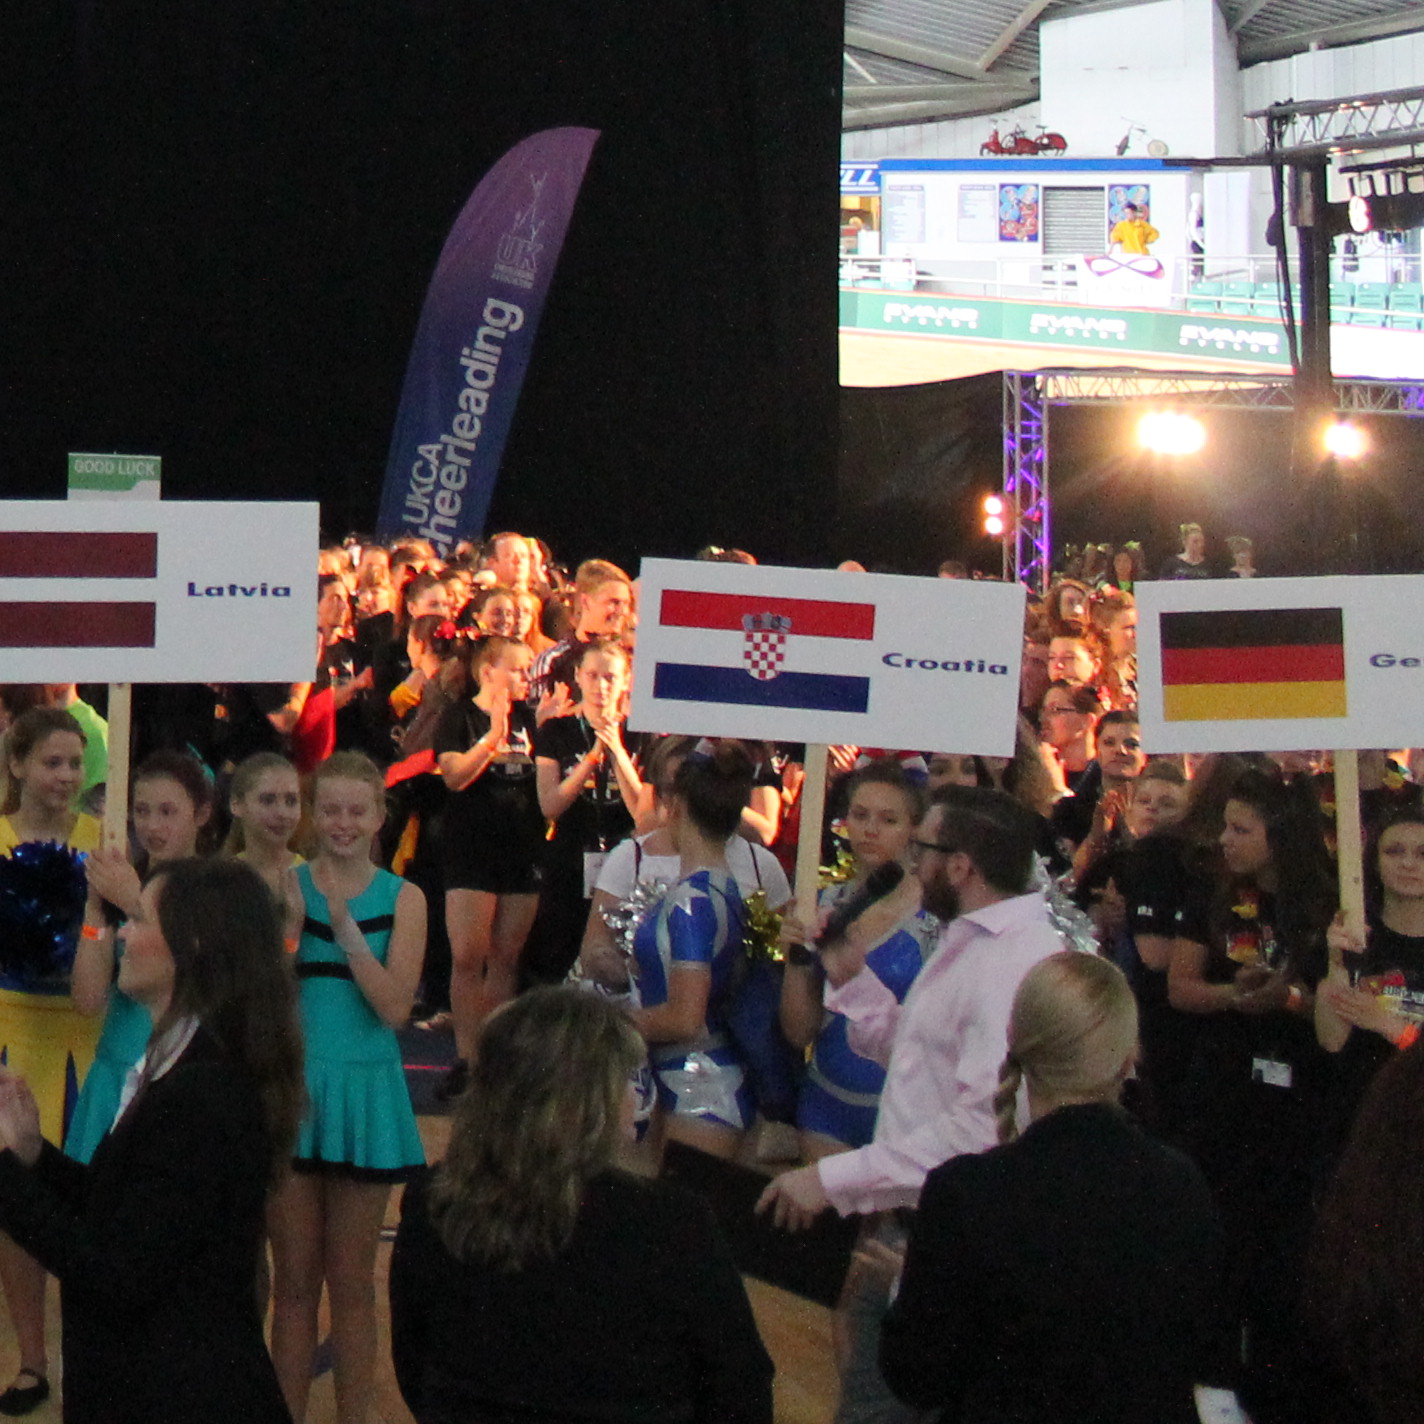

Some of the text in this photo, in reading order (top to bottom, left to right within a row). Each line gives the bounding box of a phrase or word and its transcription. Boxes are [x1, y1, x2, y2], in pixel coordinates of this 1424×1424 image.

[74, 458, 155, 476] GOOD LUCK
[402, 443, 444, 524] UKCA
[187, 581, 291, 597] Latvia
[882, 652, 1008, 675] Croatia
